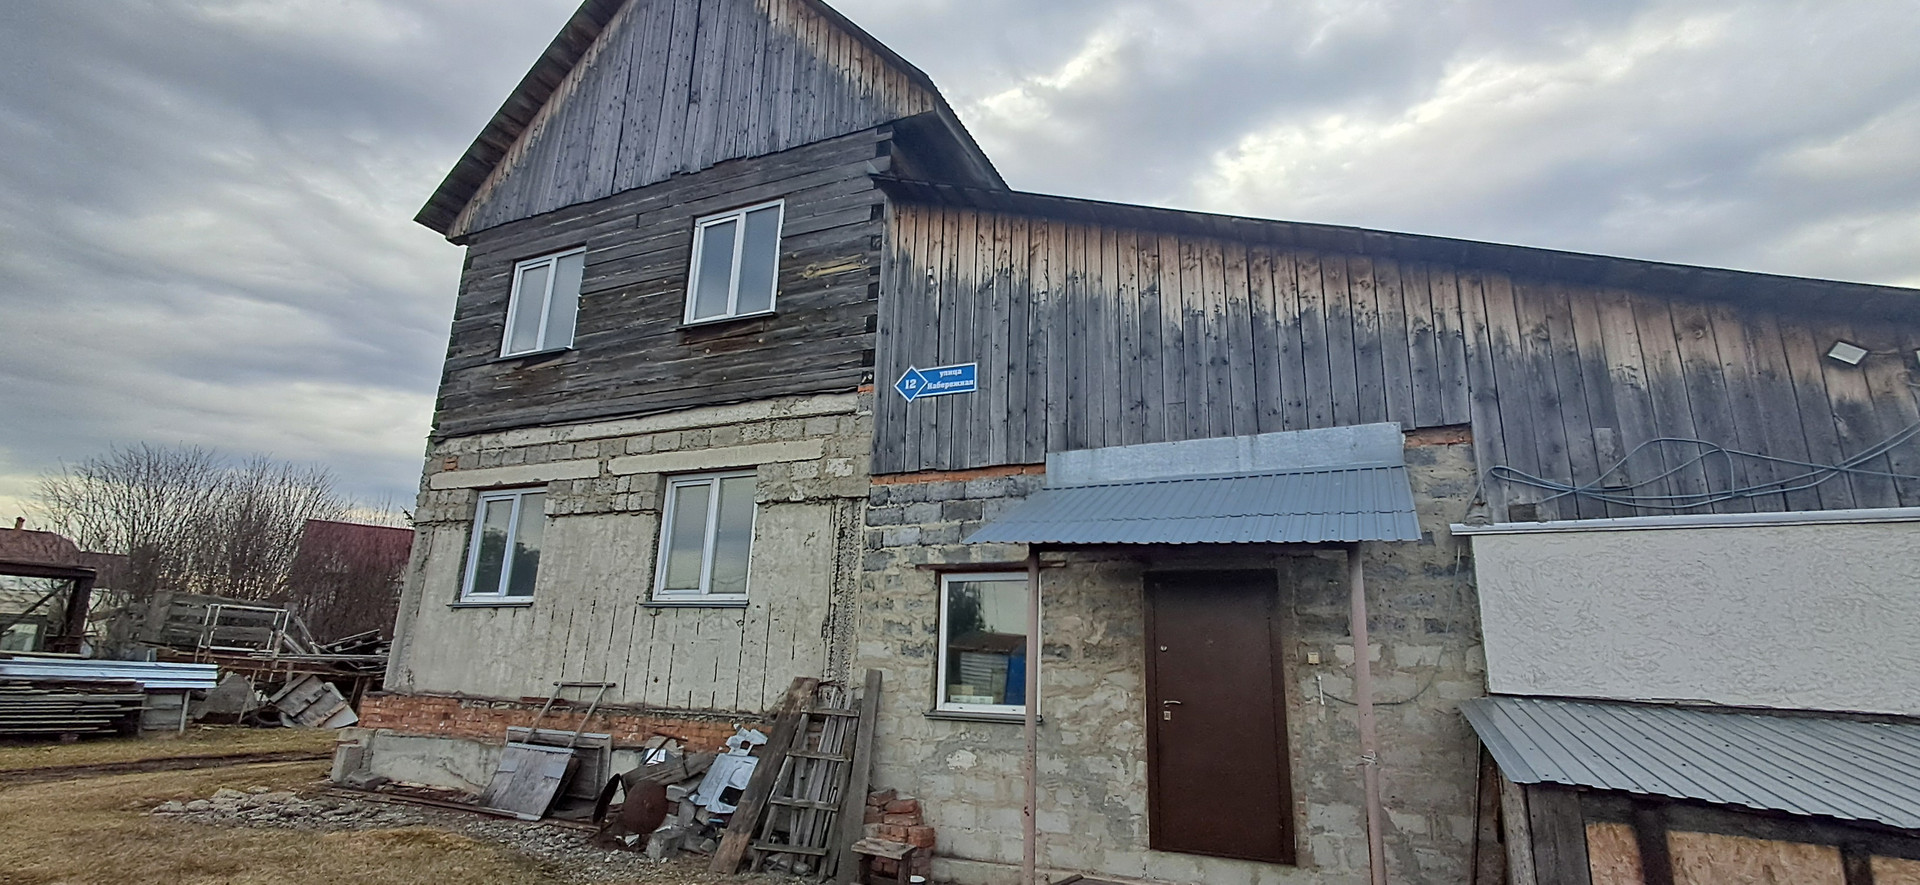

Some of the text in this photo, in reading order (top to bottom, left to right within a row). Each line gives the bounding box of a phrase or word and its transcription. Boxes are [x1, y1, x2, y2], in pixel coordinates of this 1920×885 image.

[939, 369, 962, 378] улица
[905, 379, 916, 389] 12
[927, 379, 974, 389] Набережная
